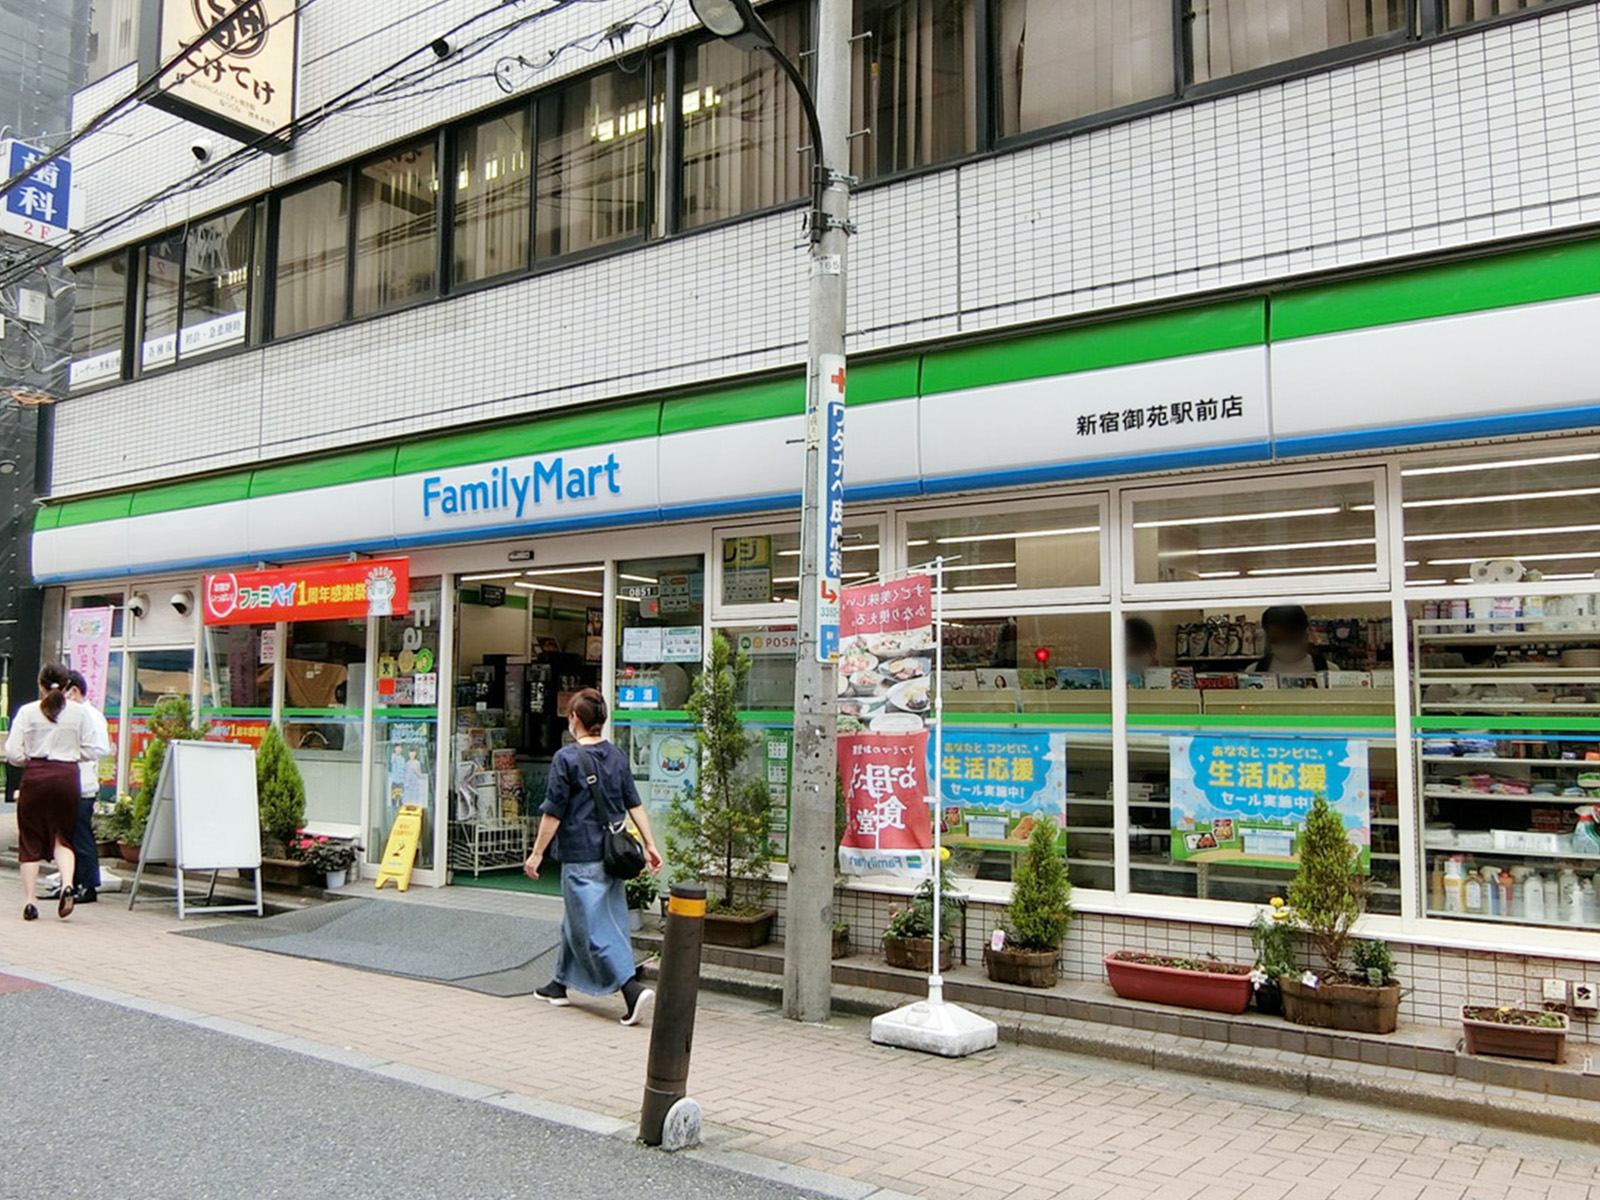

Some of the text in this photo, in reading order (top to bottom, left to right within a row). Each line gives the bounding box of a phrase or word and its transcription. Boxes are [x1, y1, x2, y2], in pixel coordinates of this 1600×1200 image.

[178, 40, 275, 105] てけてけ
[17, 152, 60, 222] 歯科
[24, 221, 51, 239] 2F
[1076, 395, 1243, 436] 新宿御苑駅前店
[423, 453, 620, 517] FamilyMart
[723, 540, 757, 563] レジ
[240, 580, 367, 609] ファミペイ1周年感謝祭
[1211, 745, 1323, 760] あなたと、コンビに、
[941, 756, 1034, 781] 生活応援
[1208, 761, 1327, 792] 生活応援
